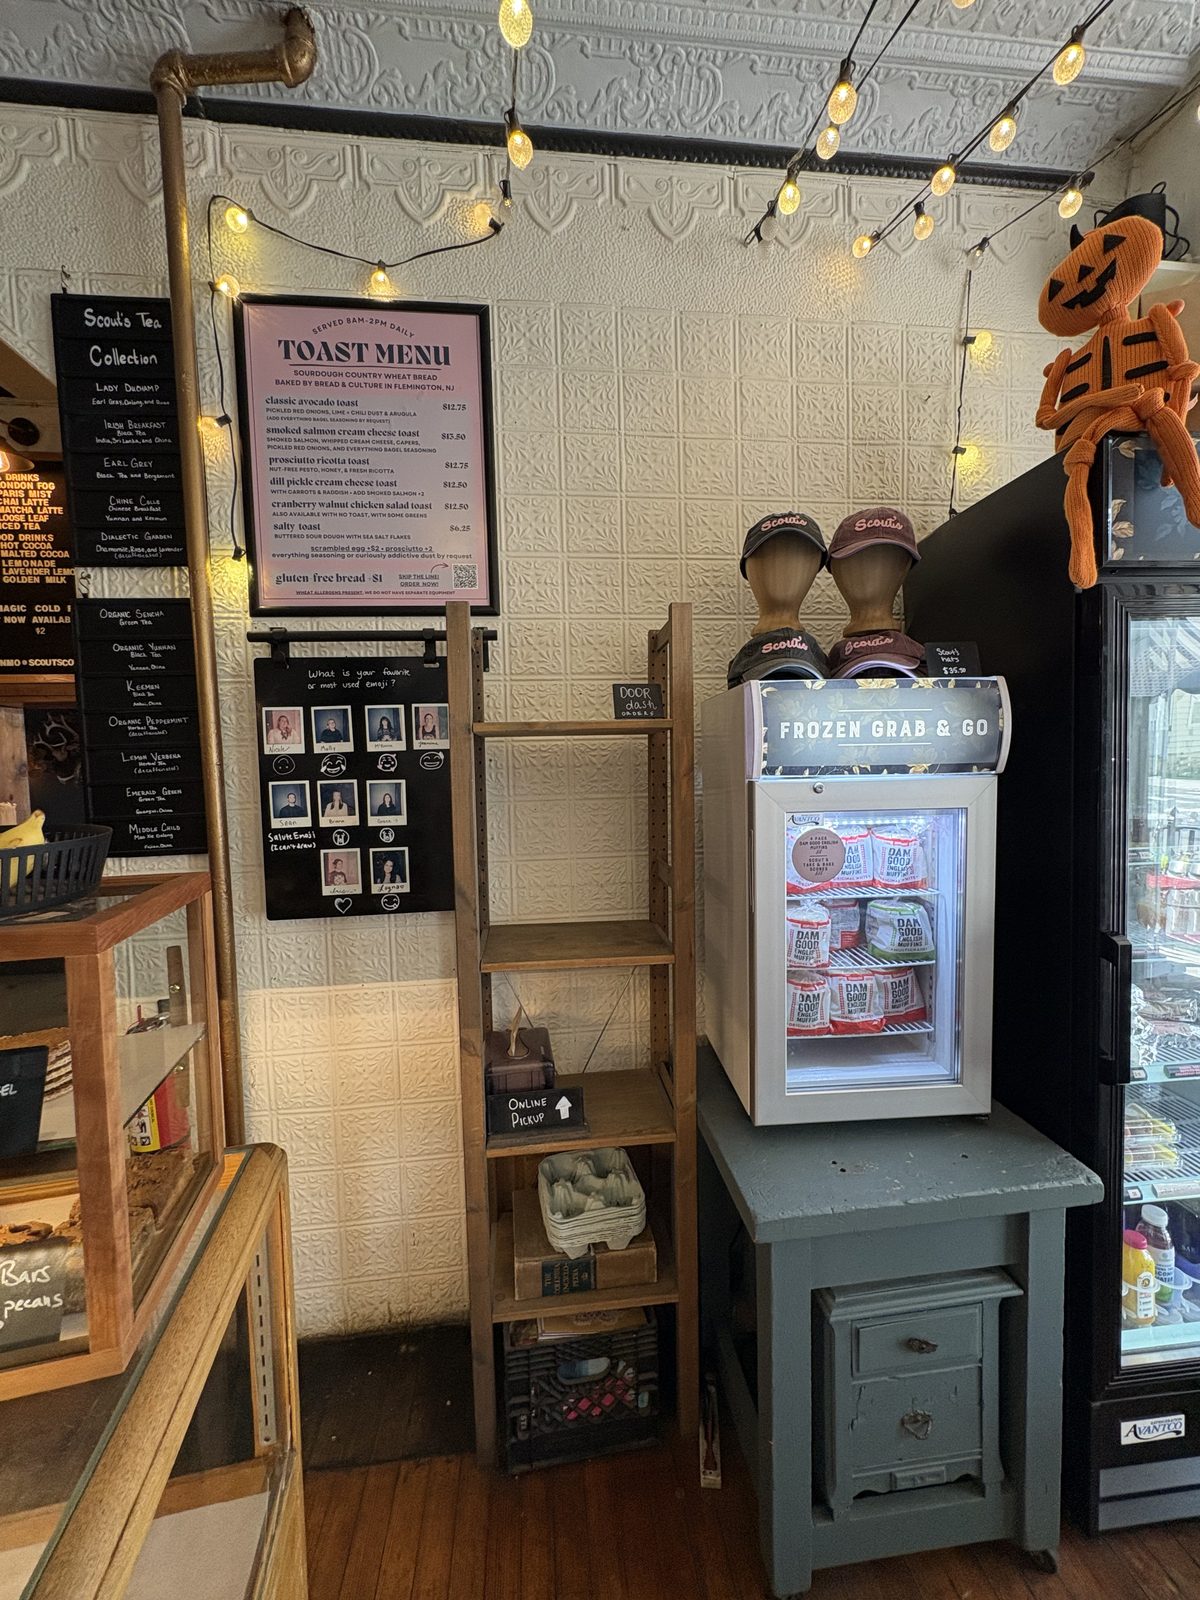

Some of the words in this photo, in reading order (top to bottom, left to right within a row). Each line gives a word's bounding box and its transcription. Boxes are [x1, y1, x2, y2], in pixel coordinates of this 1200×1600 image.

[84, 307, 132, 328] Scout's
[135, 312, 162, 329] Tea
[312, 318, 344, 335] SERVED
[346, 317, 387, 327] 8AM-2PM
[389, 323, 415, 339] DAILY
[89, 344, 158, 367] Collection
[277, 339, 369, 363] TOAST
[375, 343, 451, 366] MENU
[293, 369, 344, 378] SOURDOUGH
[344, 371, 382, 380] COUNTRY
[383, 372, 412, 381] WHEAT
[412, 373, 438, 381] BREAD
[95, 382, 119, 392] LADY
[302, 379, 313, 387] BY
[314, 380, 340, 388] BREAD
[341, 380, 347, 388] &
[348, 381, 383, 390] CULTURE
[393, 383, 445, 392] FLEMINGTON,
[445, 384, 455, 392] NJ
[265, 395, 297, 406] classic
[298, 397, 335, 407] avocado
[336, 398, 359, 407] toast
[442, 403, 467, 412] $12.75
[104, 419, 125, 430] IRISH
[127, 419, 167, 430] BREAKFAST
[266, 426, 302, 436] smoked
[302, 426, 336, 437] salmon
[337, 428, 366, 437] cream
[367, 427, 397, 437] cheese
[398, 429, 420, 438] toast
[441, 432, 466, 441] $13.50
[103, 457, 129, 468] EARL
[130, 457, 153, 469] GREY
[269, 456, 316, 466] prosciutto
[316, 456, 347, 465] ricotta
[347, 457, 370, 466] toast
[444, 462, 469, 470] $12.75
[5, 473, 40, 482] DRINKS
[269, 477, 285, 487] dill
[286, 477, 314, 488] pickle
[314, 479, 343, 487] cream
[344, 478, 375, 488] cheese
[375, 479, 398, 488] toast
[0, 481, 34, 489] ONDON
[36, 482, 56, 490] FOG
[442, 481, 468, 489] $12.50
[28, 490, 53, 498] MIST
[22, 498, 50, 506] LATTE
[271, 499, 317, 511] cranberry
[317, 501, 349, 510] walnut
[350, 501, 385, 510] chicken
[386, 501, 410, 510] salad
[411, 502, 433, 511] toast
[444, 502, 469, 511] $12.50
[37, 506, 64, 515] LATTE
[28, 514, 49, 522] LEAF
[854, 515, 904, 532] Scout's
[23, 522, 41, 530] TEA
[273, 521, 295, 533] salty
[298, 522, 321, 531] toast
[449, 524, 471, 533] $6.25
[760, 515, 808, 533] Scout's
[18, 534, 54, 542] DRINKS
[101, 531, 139, 541] DIALECTIC
[144, 531, 173, 541] GARDEN
[0, 541, 20, 550] HOT
[22, 542, 53, 550] COCOA
[385, 545, 424, 553] prosciutto
[0, 550, 37, 558] MALTED
[39, 550, 70, 558] COCOA
[271, 552, 310, 560] everything
[310, 552, 346, 560] seasoning
[355, 552, 386, 560] curiously
[387, 552, 420, 560] addictive
[436, 553, 445, 561] by
[446, 553, 473, 561] request
[1, 559, 56, 568] LEMONADE
[2, 567, 51, 576] LAVENDER
[2, 575, 40, 584] GOLDEN
[45, 576, 67, 584] MILK
[336, 573, 366, 583] bread
[34, 604, 61, 613] COLD
[99, 608, 132, 619] ORGANIC
[135, 609, 165, 620] SENCHA
[3, 615, 26, 624] NOW
[112, 643, 145, 652] ORGANIC
[761, 635, 809, 654] Scout's
[844, 635, 894, 656] Scout's
[308, 669, 335, 679] What
[342, 668, 351, 677] is
[357, 669, 376, 680] your
[382, 668, 411, 677] favorite
[320, 681, 337, 690] most
[342, 680, 360, 689] used
[619, 686, 652, 700] DOOR
[625, 699, 658, 710] dash
[108, 715, 142, 727] ORGANIC
[779, 720, 861, 740] FROZEN
[871, 719, 927, 738] GRAB
[935, 719, 951, 737] &
[961, 718, 989, 736] GO
[126, 787, 157, 798] EMERALD
[128, 823, 158, 835] MIDDLE
[161, 822, 181, 832] CHILD
[887, 847, 911, 858] DAM
[887, 856, 911, 866] GOOD
[897, 918, 921, 928] DAM
[796, 930, 820, 941] DAM
[898, 928, 923, 937] GOOD
[794, 940, 819, 950] GOOD
[845, 983, 868, 993] DAM
[890, 977, 910, 990] DAM
[798, 992, 821, 1003] DAM
[846, 992, 867, 1002] GOOD
[891, 986, 910, 998] GOOD
[798, 1002, 820, 1013] GOOD
[508, 1097, 547, 1111] ONLINE
[511, 1112, 545, 1128] PICKUP
[0, 1259, 51, 1287] Bars
[3, 1293, 64, 1319] pecans
[1124, 1421, 1183, 1440] AVANTCO
